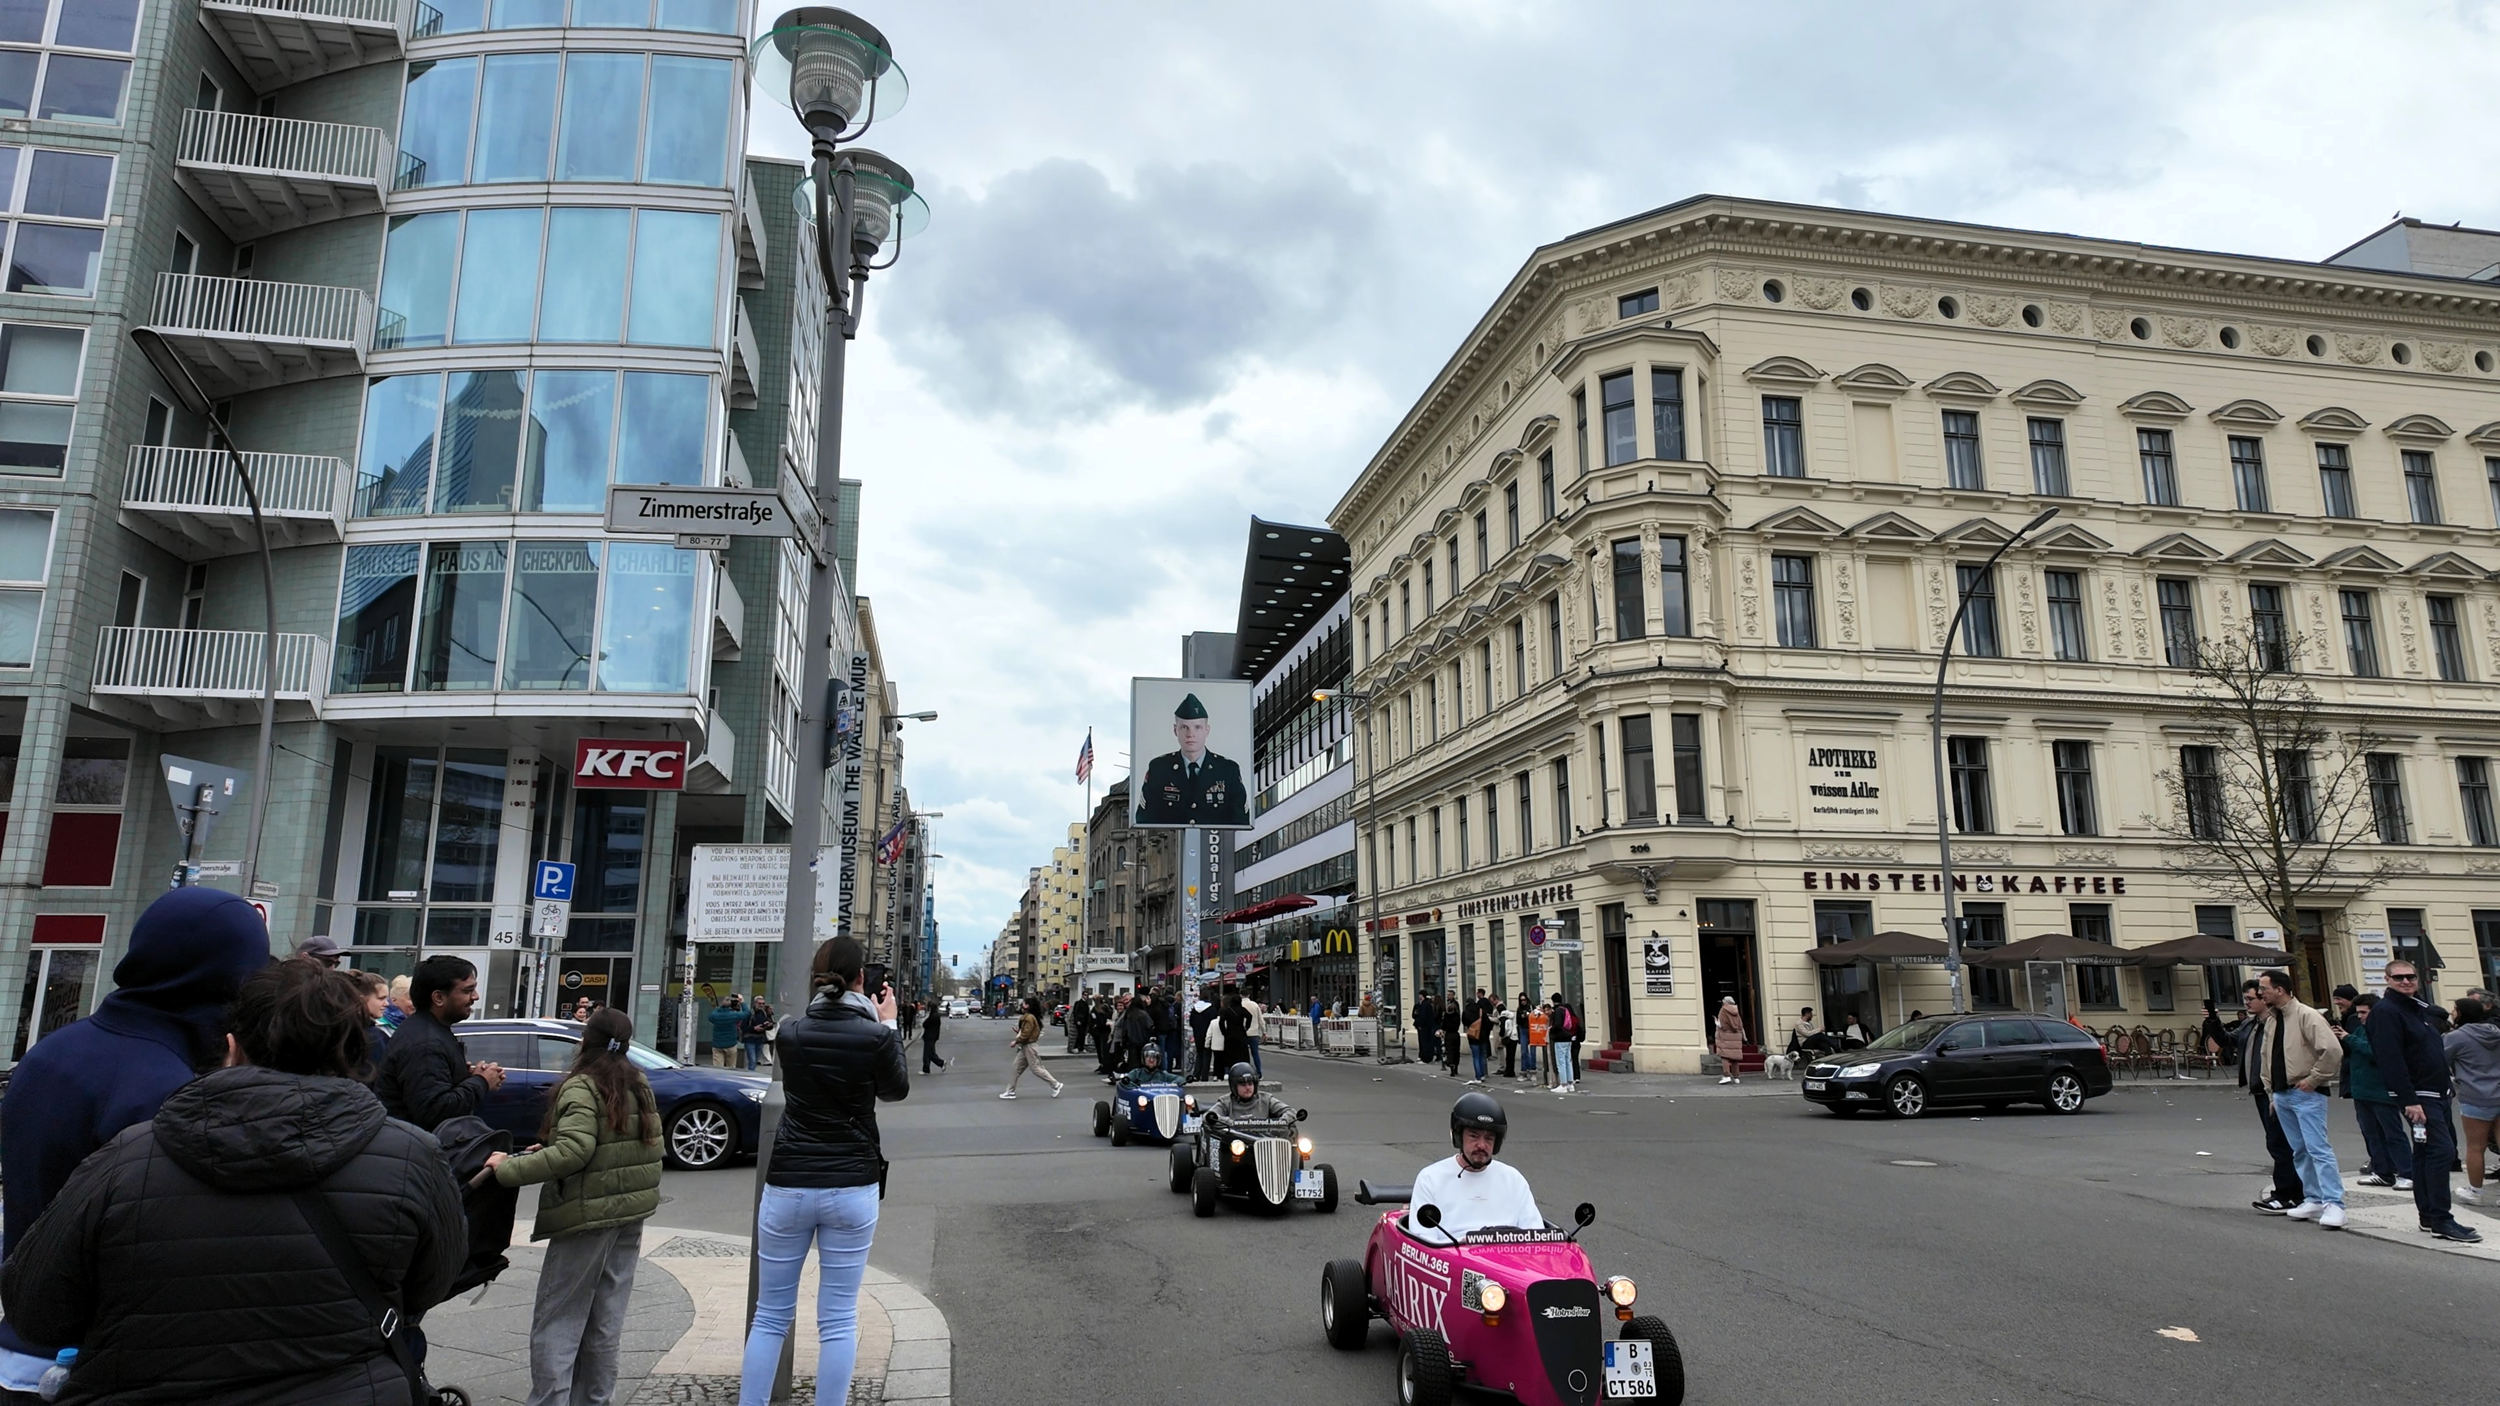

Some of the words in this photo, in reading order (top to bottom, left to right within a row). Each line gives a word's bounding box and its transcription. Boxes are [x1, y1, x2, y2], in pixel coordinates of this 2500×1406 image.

[638, 496, 773, 526] Zimmerstraße
[689, 537, 701, 545] 80
[710, 538, 722, 546] 77
[437, 550, 481, 573] HAUS
[521, 550, 599, 573] CHECKPOIN
[614, 551, 690, 574] CHARLIE
[851, 655, 868, 693] MUR
[577, 748, 679, 779] KFC
[1808, 747, 1877, 769] APOTHEKE
[844, 765, 861, 793] THE
[1809, 783, 1849, 798] weissen
[1850, 781, 1880, 799] Adler
[711, 847, 723, 855] YOU
[1629, 842, 1650, 854] 206
[838, 800, 860, 932] MAUERMUSEUM
[541, 866, 563, 894] P
[888, 857, 898, 909] CHECKPO
[1803, 871, 1968, 892] EINSTEIN
[2002, 875, 2126, 894] KAFFEE
[1458, 897, 1509, 918] EINSTEIN
[1521, 883, 1574, 907] KAFFEE
[886, 912, 895, 930] AM
[494, 931, 513, 944] 45
[2100, 957, 2123, 965] KAFFEE
[2210, 957, 2243, 965] EINSTEIN
[583, 976, 606, 984] CASH
[1234, 1118, 1288, 1126] www.hotrod.berlin
[1309, 1171, 1315, 1179] B
[1296, 1188, 1307, 1198] CT
[1307, 1189, 1322, 1198] 752
[1467, 1230, 1564, 1244] www.hotrod.berlin
[1401, 1242, 1450, 1276] BERLIN.365
[1383, 1249, 1452, 1345] MATRIX
[1629, 1343, 1638, 1359] B
[1609, 1380, 1626, 1396] CT
[1628, 1379, 1654, 1396] 586
